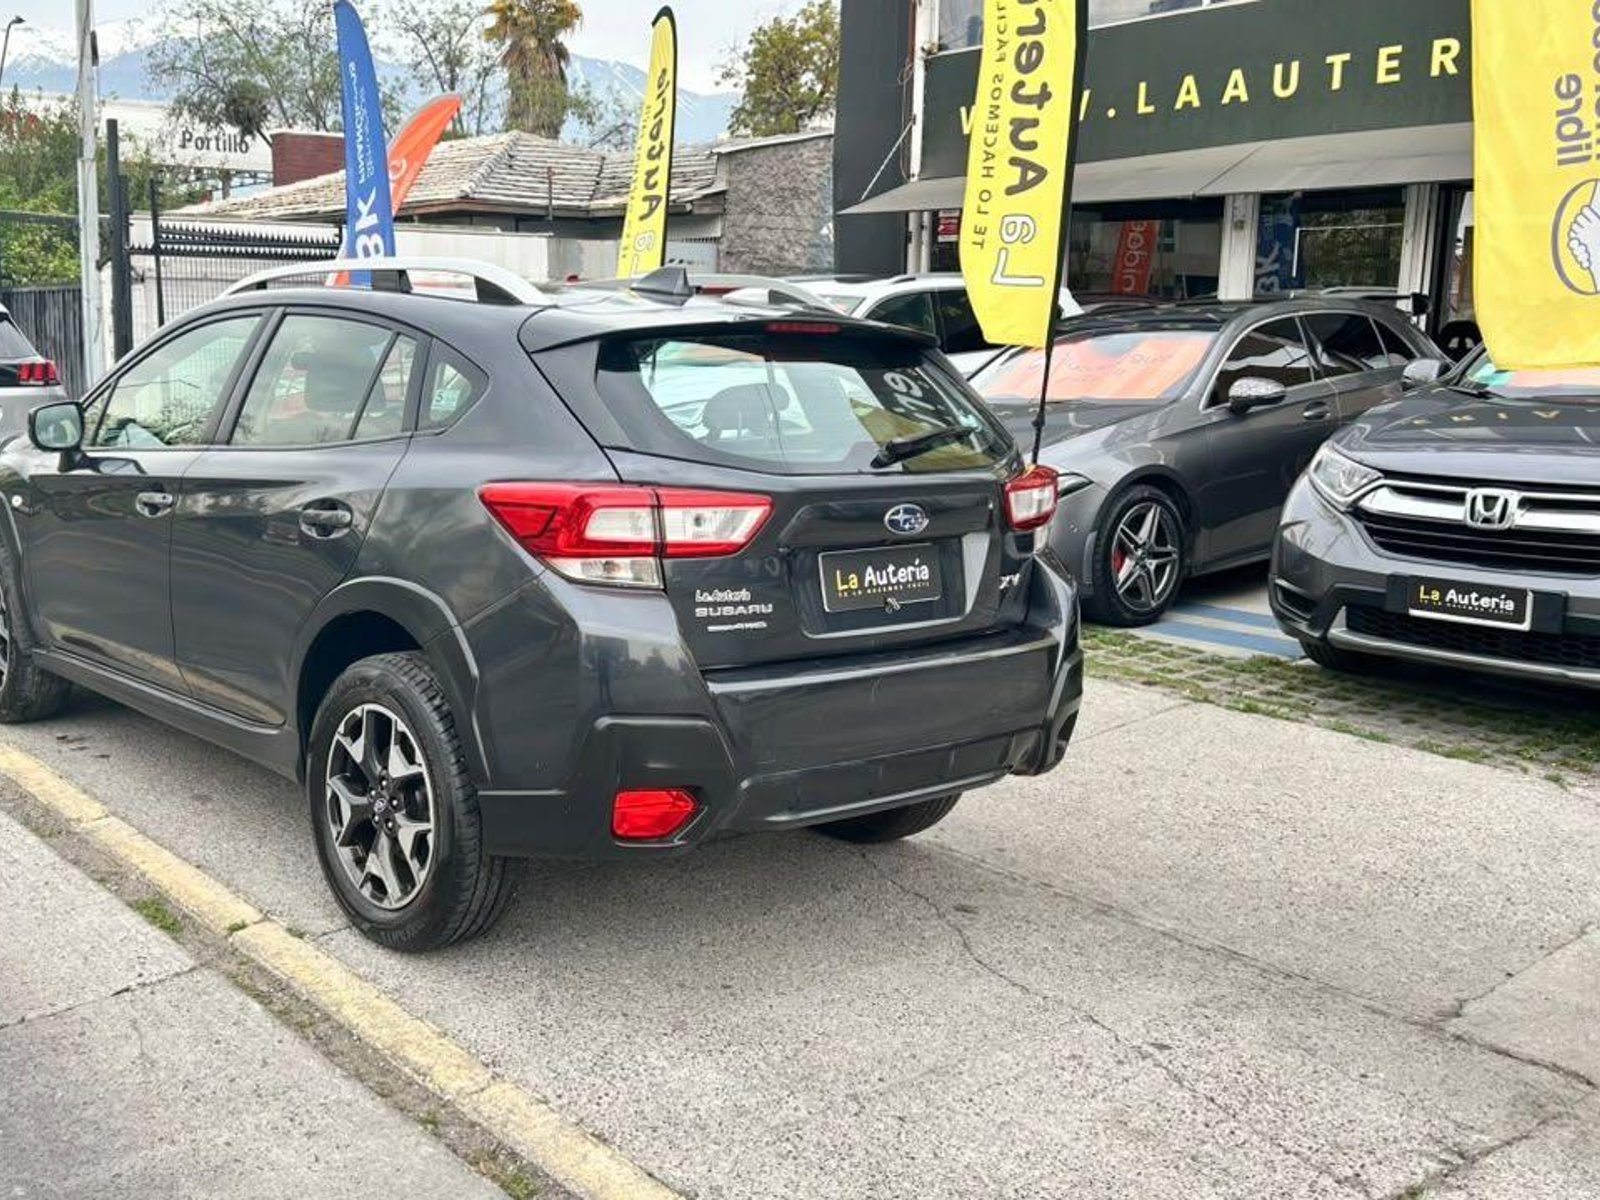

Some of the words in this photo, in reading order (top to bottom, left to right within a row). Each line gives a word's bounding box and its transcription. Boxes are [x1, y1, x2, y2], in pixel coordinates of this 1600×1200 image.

[179, 128, 249, 153] Portillo
[836, 569, 859, 591] La
[864, 558, 930, 587] Autería
[695, 603, 773, 617] SUBARU
[1419, 585, 1440, 601] La
[1445, 589, 1515, 611] Autería
